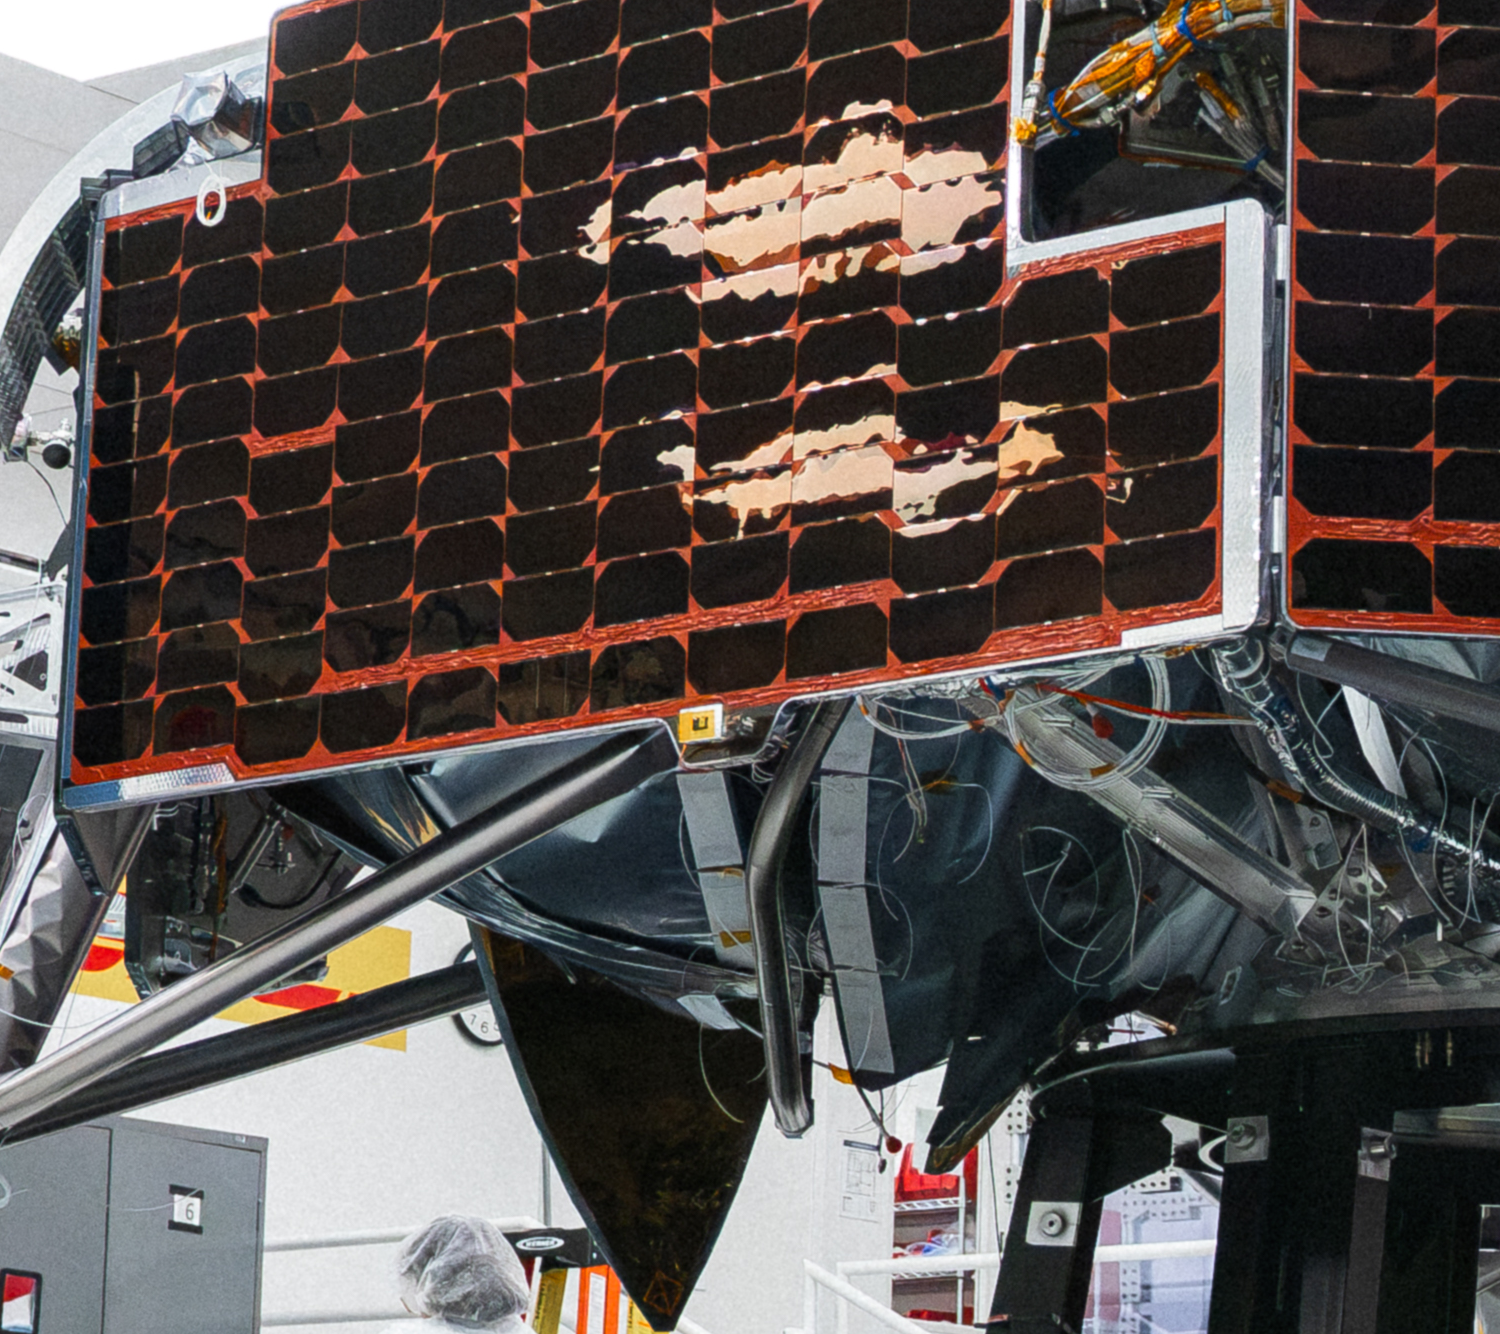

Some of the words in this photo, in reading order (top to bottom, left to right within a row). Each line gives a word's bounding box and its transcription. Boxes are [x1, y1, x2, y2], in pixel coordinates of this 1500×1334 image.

[469, 1014, 477, 1025] 7
[480, 1021, 489, 1034] 6
[185, 1202, 195, 1221] 6
